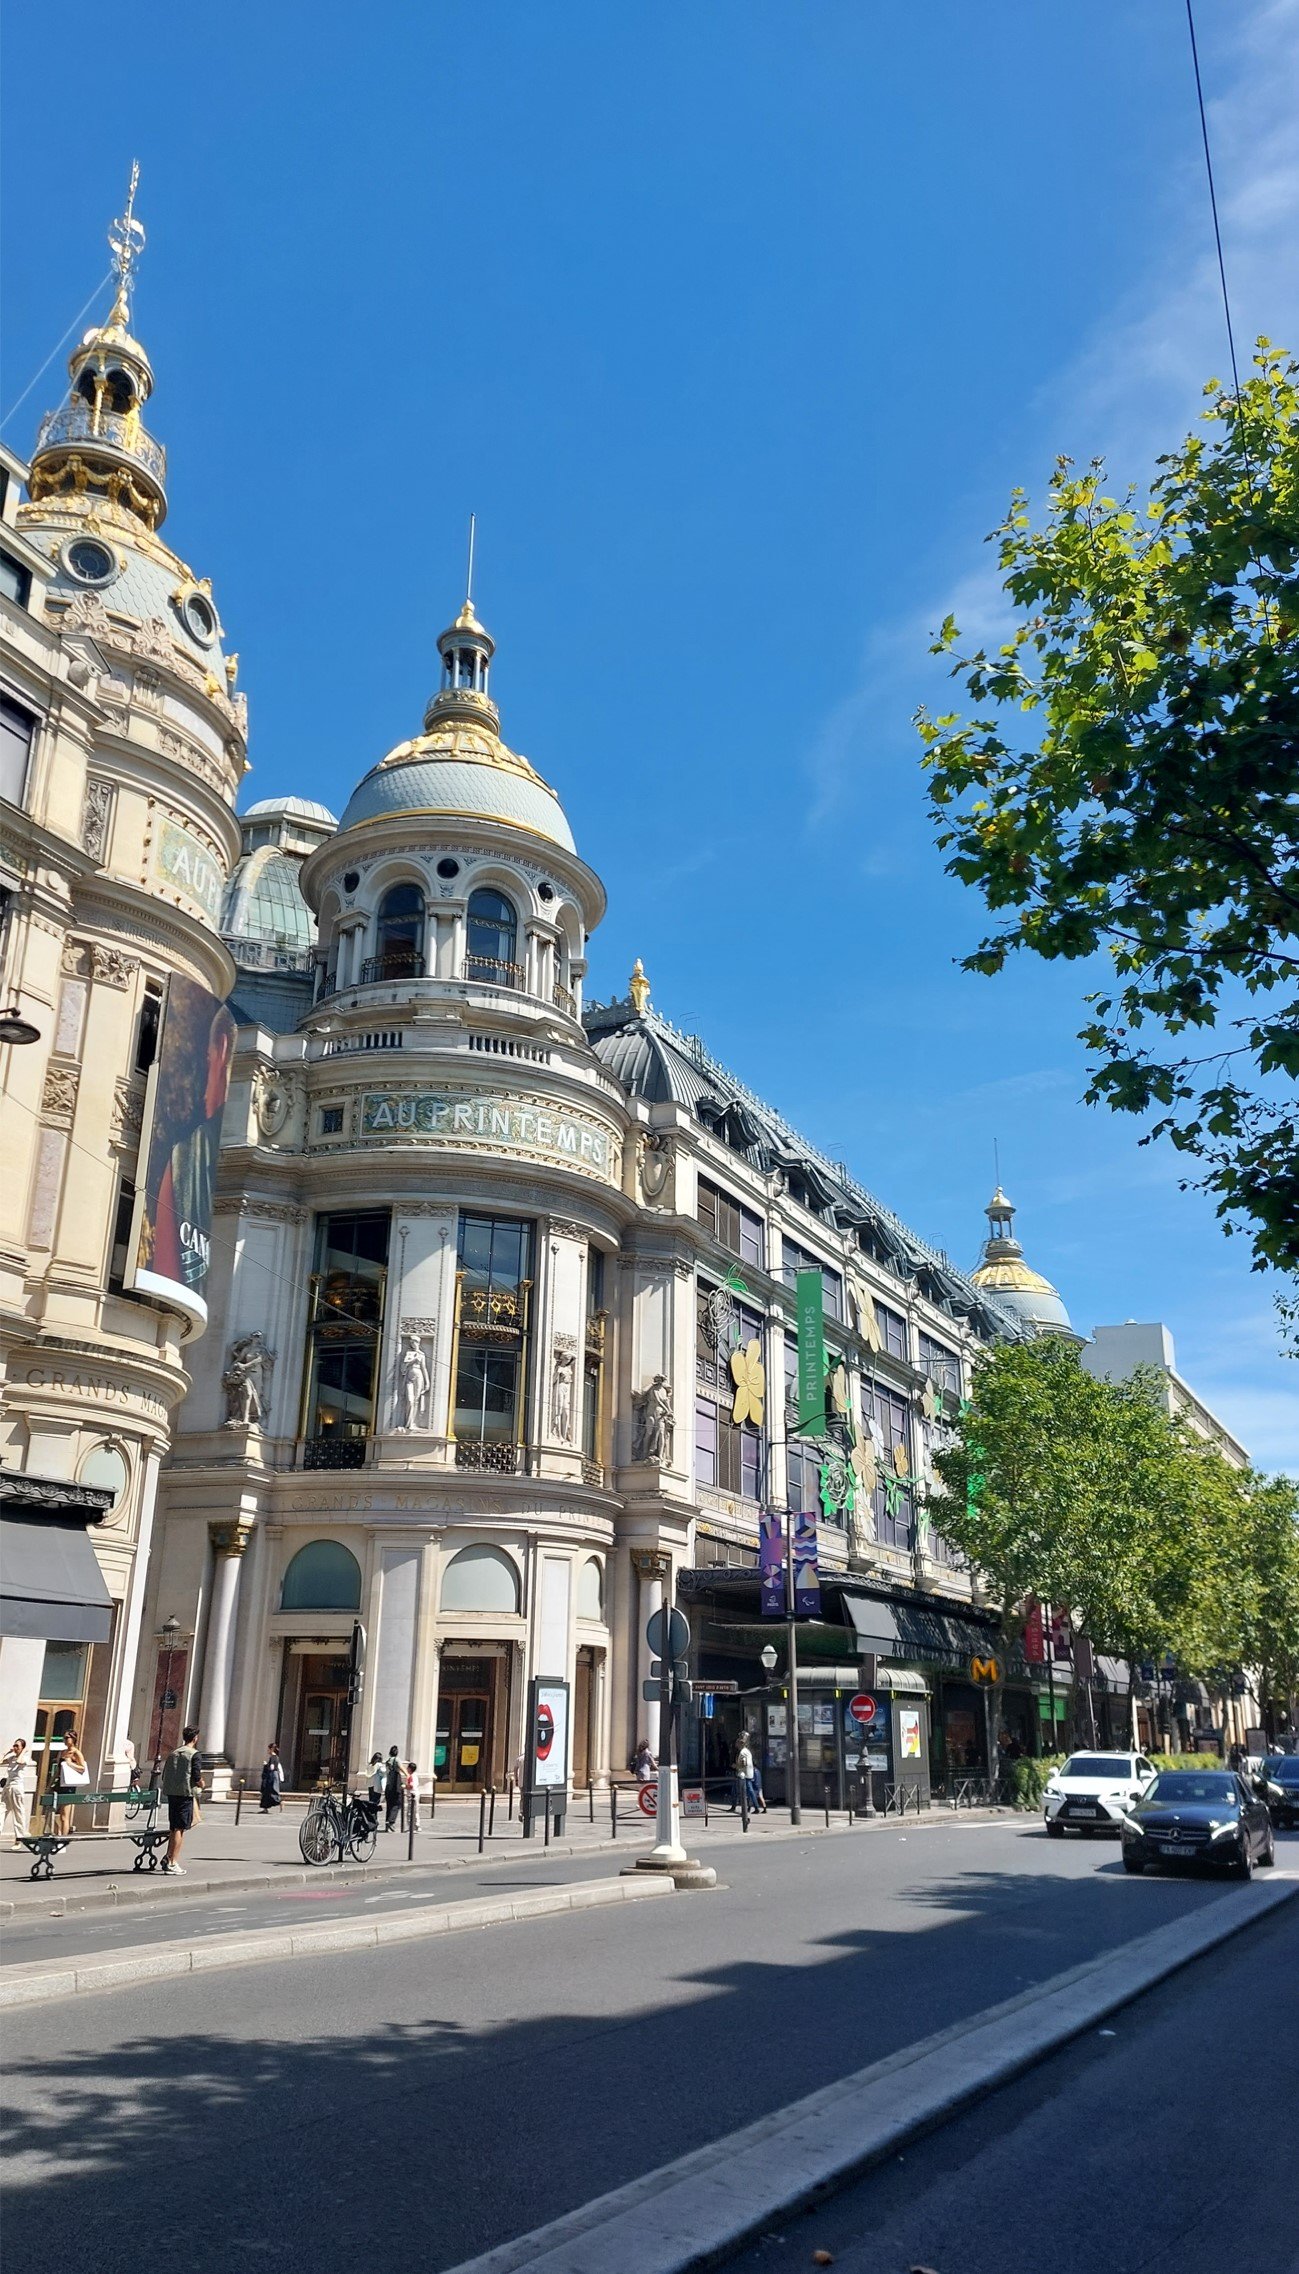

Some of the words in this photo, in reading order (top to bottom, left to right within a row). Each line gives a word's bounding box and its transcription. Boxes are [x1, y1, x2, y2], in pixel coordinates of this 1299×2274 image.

[171, 846, 208, 894] AU
[372, 1102, 416, 1127] AU
[431, 1102, 603, 1165] PRINTEMPS
[804, 1306, 817, 1401] PRINTEMPS
[25, 1368, 130, 1404] GRANDS
[291, 1494, 373, 1511] GRANDS
[521, 1500, 544, 1516] DU
[972, 1657, 997, 1681] M
